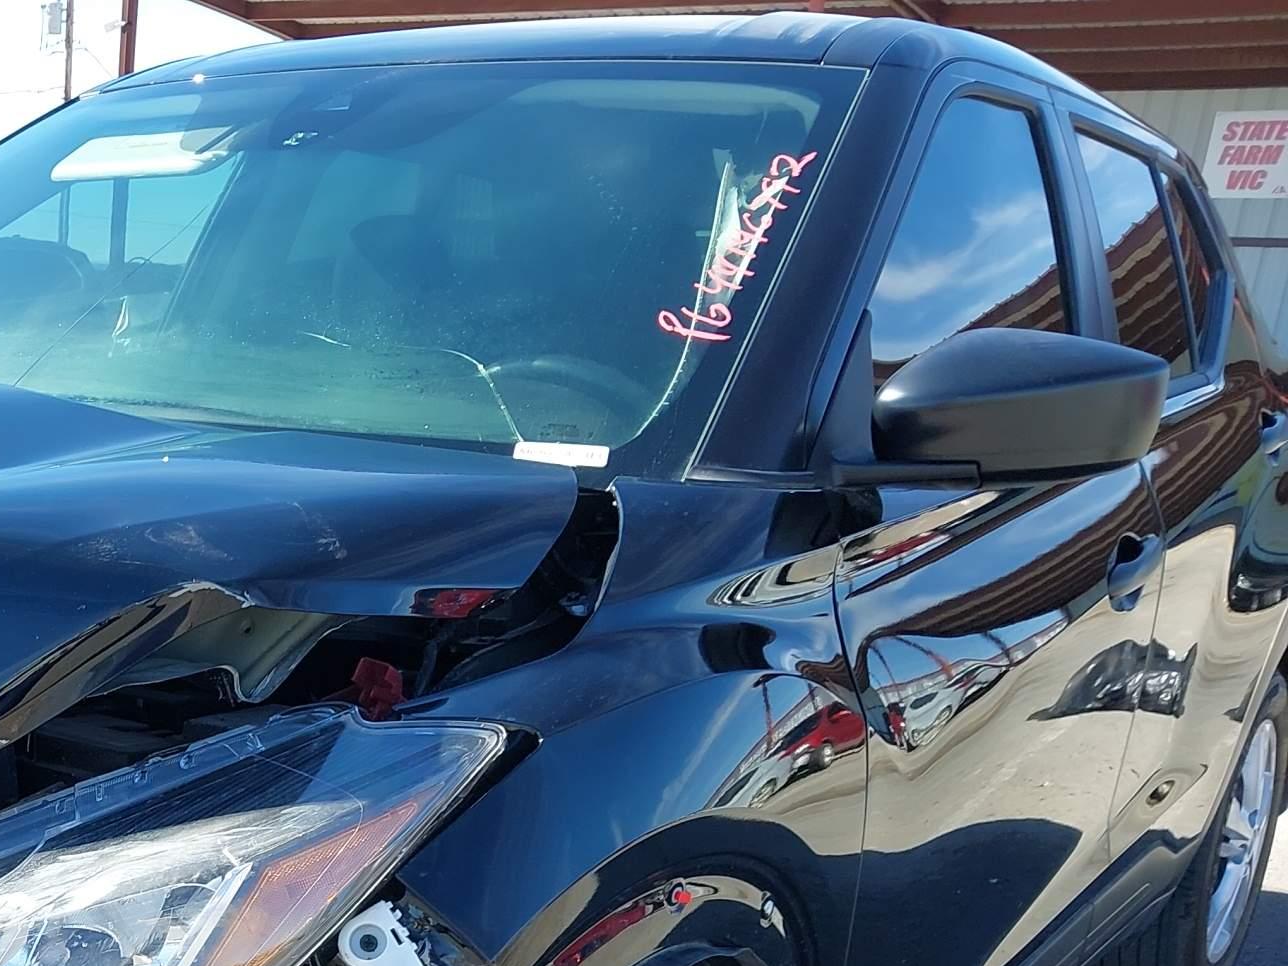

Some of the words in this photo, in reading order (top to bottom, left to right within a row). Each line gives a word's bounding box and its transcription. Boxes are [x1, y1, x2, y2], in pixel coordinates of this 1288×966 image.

[1222, 120, 1288, 142] STATE
[1217, 144, 1285, 166] FARM
[1225, 169, 1268, 191] VIC
